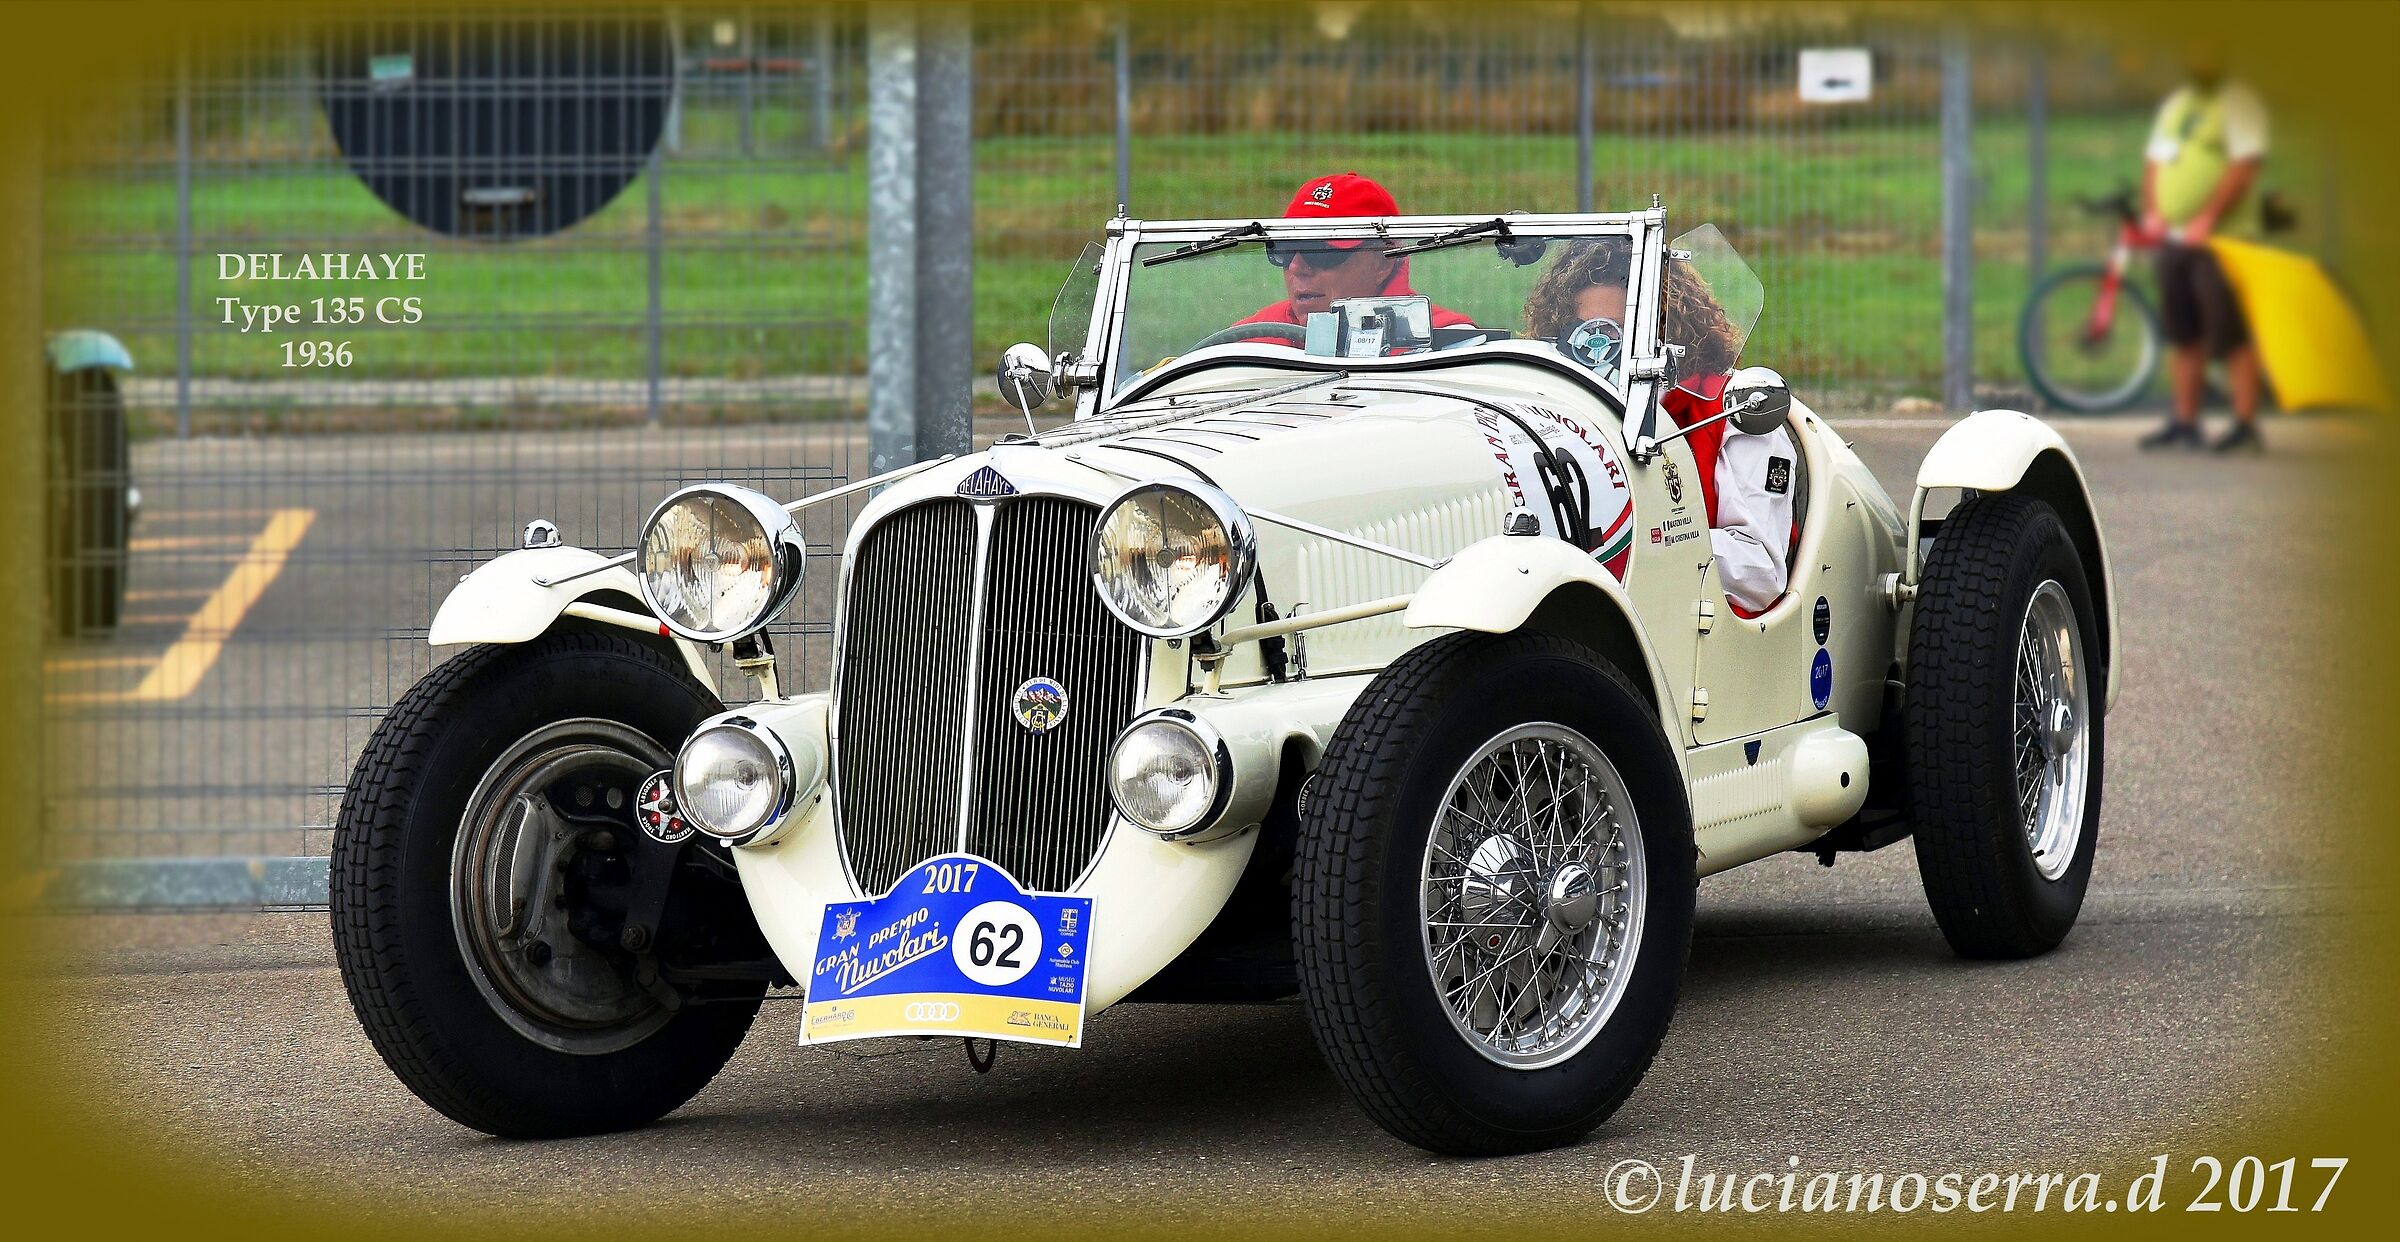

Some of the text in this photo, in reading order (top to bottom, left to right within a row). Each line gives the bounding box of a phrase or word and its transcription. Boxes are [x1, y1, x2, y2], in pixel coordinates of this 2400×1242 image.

[1484, 433, 1526, 507] GRAN
[1515, 402, 1627, 490] NUVOLARI
[960, 467, 1010, 495] DELAHAYE
[1533, 446, 1605, 553] 62
[1814, 663, 1829, 679] 2017
[640, 778, 692, 841] HARTFORD SHOCK ABSORBER
[922, 863, 979, 895] 2017
[816, 907, 929, 976] GRAN PREMIO
[835, 921, 948, 994] Nuvolari
[970, 921, 1024, 969] 62
[1048, 986, 1074, 994] NUVOLARI
[1033, 1021, 1069, 1031] GENERALI
[1034, 1013, 1059, 1023] BANCA
